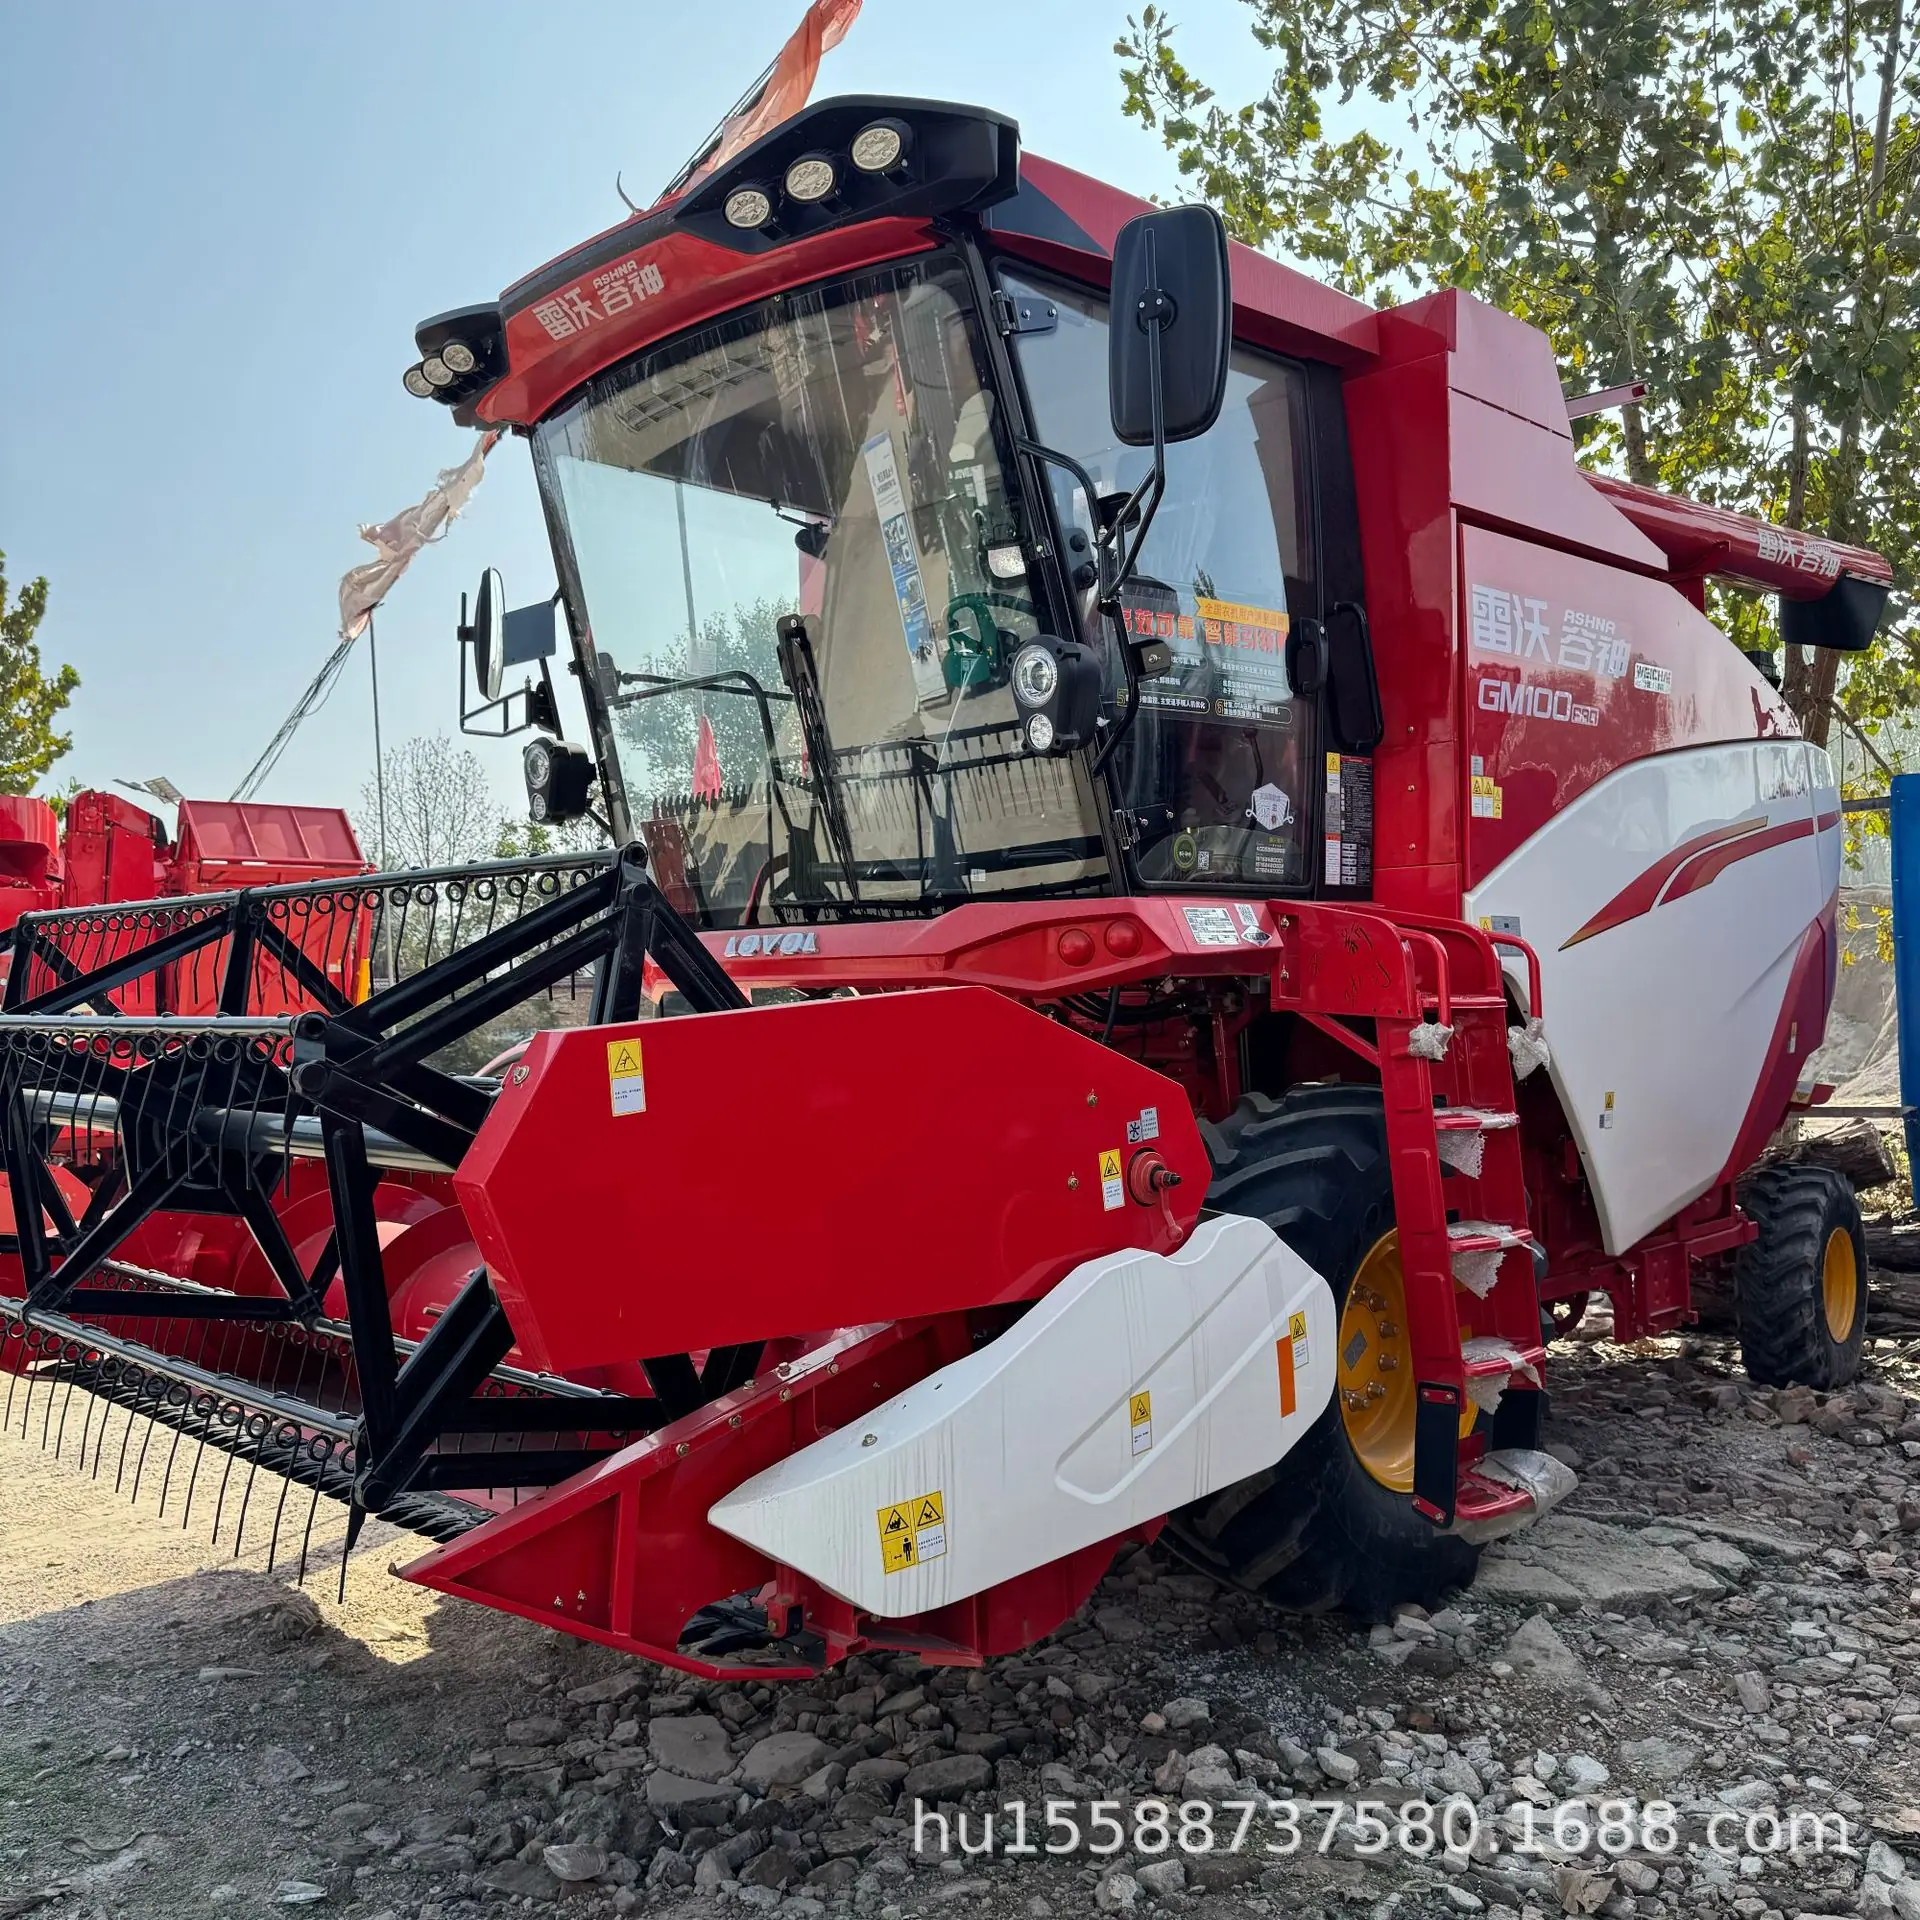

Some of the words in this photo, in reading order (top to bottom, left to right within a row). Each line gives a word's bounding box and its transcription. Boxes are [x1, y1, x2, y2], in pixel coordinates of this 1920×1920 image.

[592, 260, 638, 290] ASHNA
[1563, 609, 1616, 635] ASHNA
[1478, 678, 1573, 722] GM100
